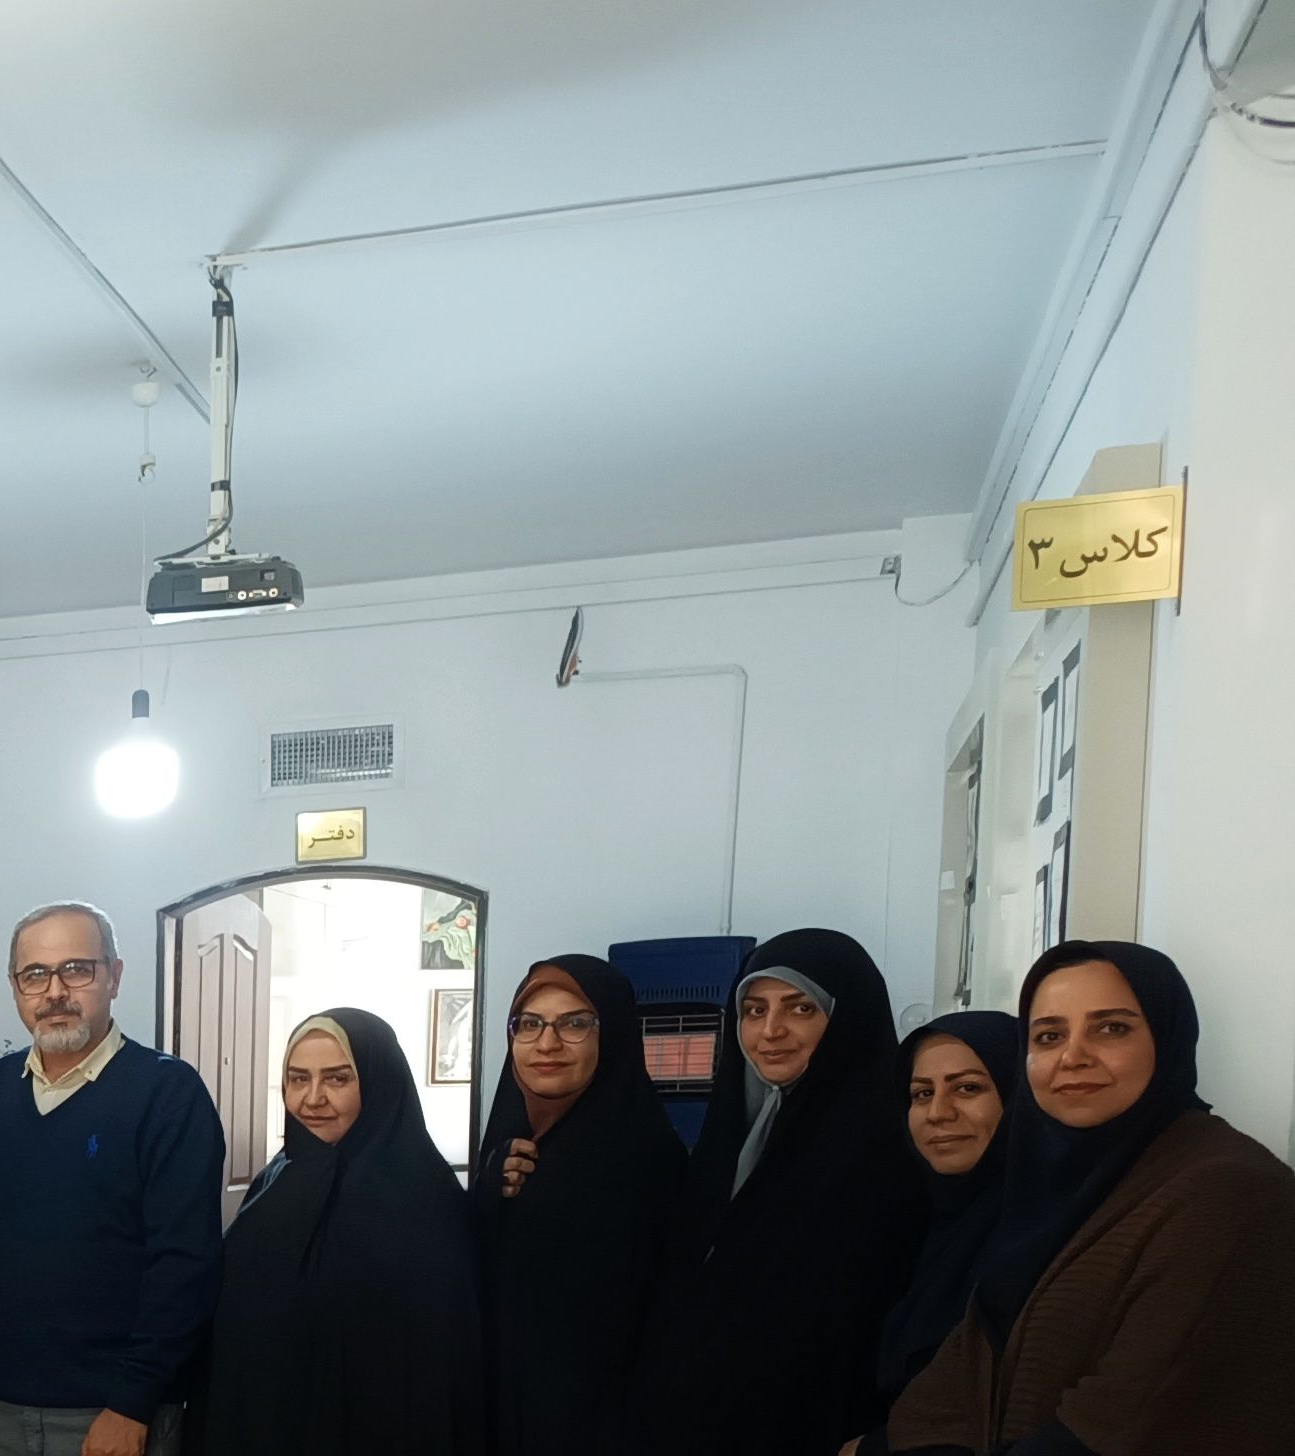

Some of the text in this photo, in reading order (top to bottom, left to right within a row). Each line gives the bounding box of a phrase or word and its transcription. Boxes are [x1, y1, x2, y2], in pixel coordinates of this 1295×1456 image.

[1027, 525, 1168, 578] کلاس ۳
[307, 824, 355, 849] دفتر
